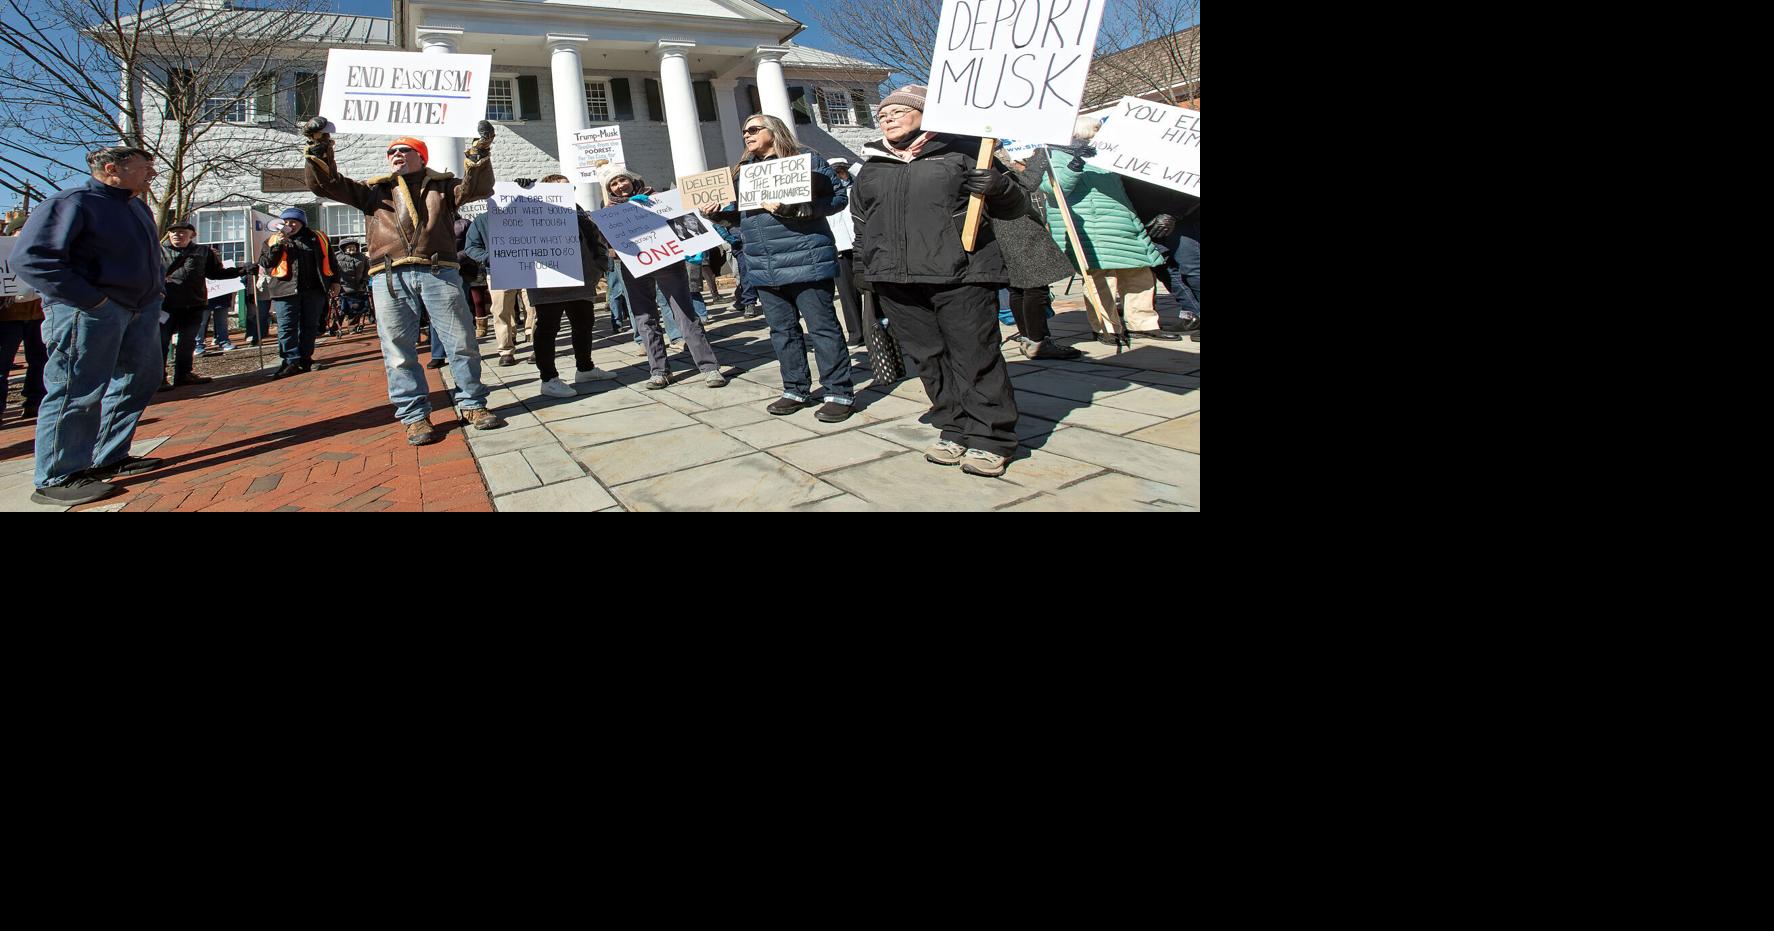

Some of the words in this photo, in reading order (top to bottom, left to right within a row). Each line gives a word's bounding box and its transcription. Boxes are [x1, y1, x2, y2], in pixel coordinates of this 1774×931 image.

[346, 65, 385, 89] END
[390, 67, 473, 92] FASCISM!
[937, 52, 1082, 110] MUSK
[341, 99, 380, 122] END
[387, 100, 448, 125] HATE!
[1124, 102, 1167, 123] YOU
[779, 157, 805, 173] FOR
[1113, 154, 1159, 176] LIVE
[685, 173, 726, 190] DELETE
[749, 177, 770, 190] THE
[773, 171, 810, 187] PEOPLE
[691, 188, 729, 205] DOGE
[740, 189, 761, 203] NOT
[550, 247, 562, 257] TO
[637, 240, 685, 266] ONE
